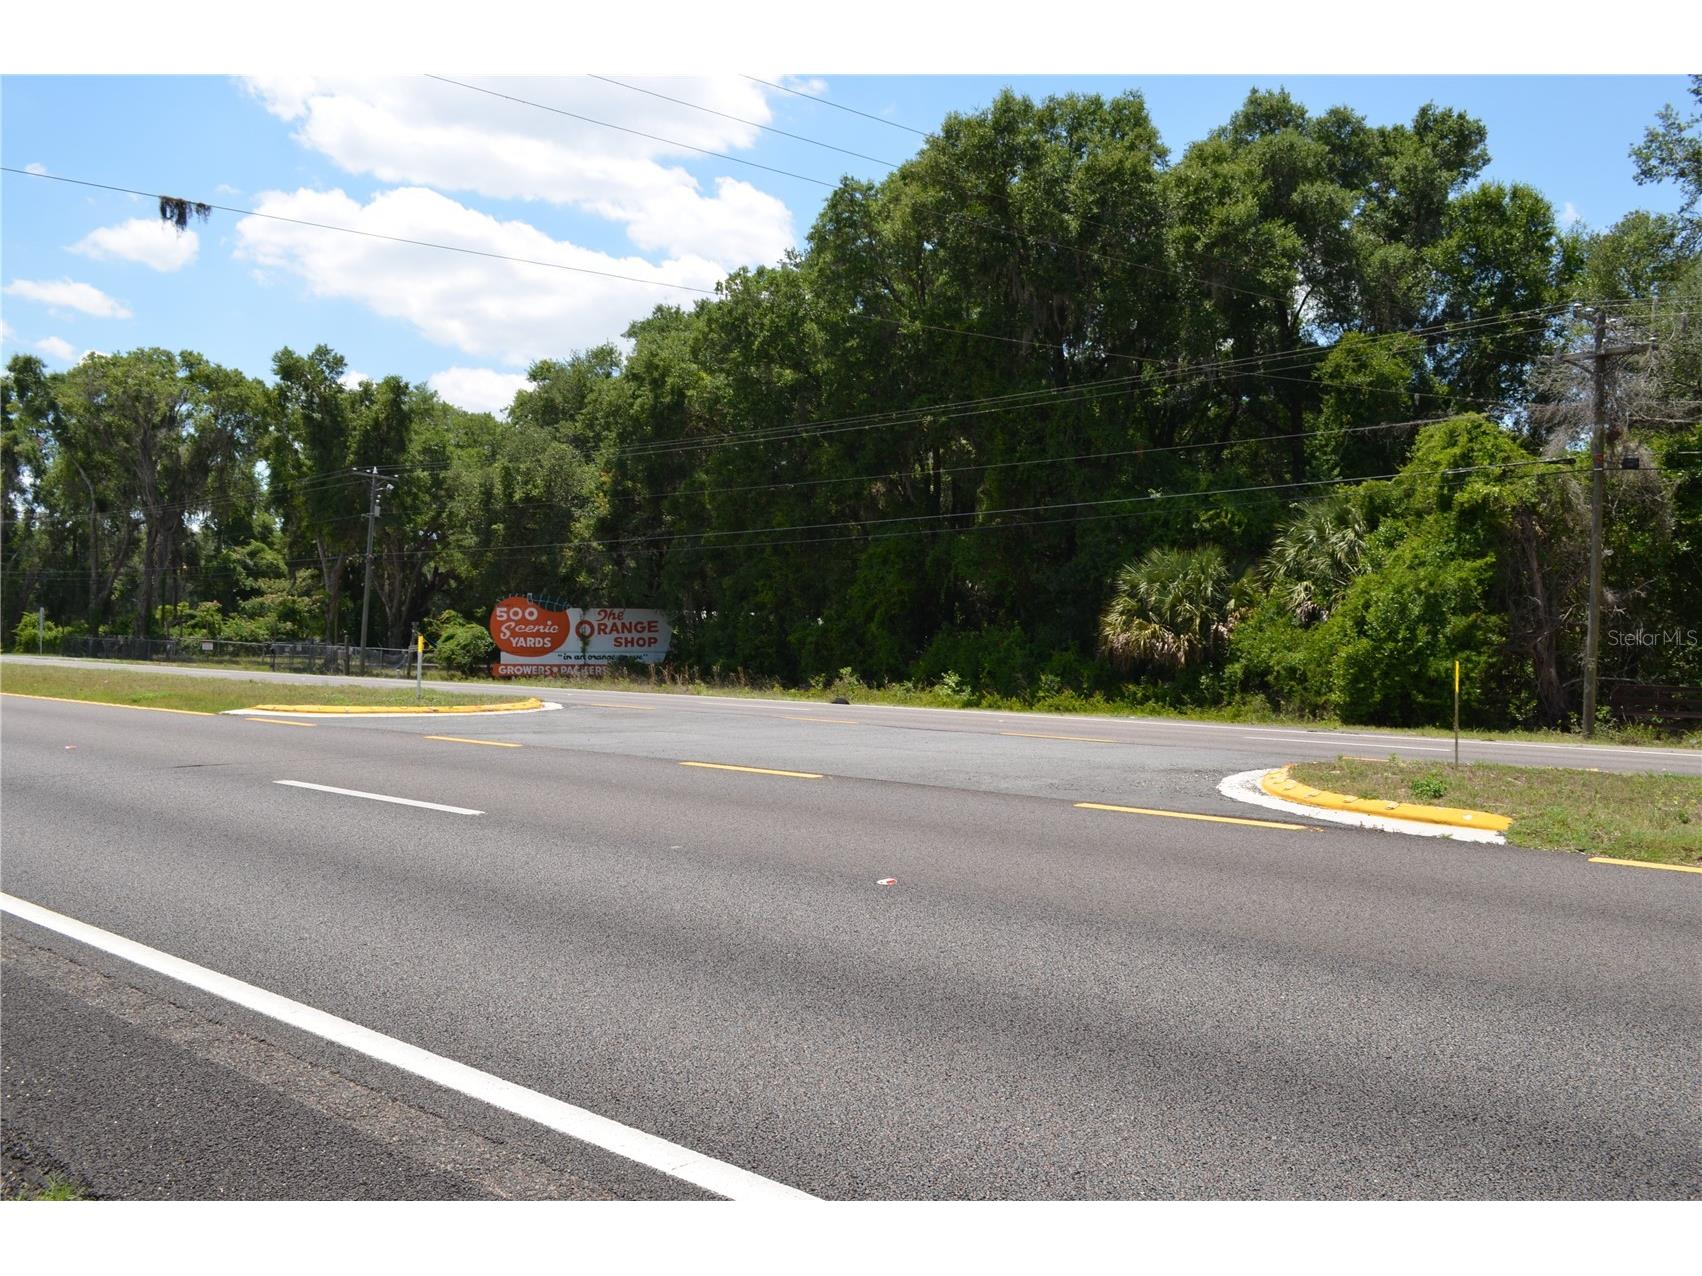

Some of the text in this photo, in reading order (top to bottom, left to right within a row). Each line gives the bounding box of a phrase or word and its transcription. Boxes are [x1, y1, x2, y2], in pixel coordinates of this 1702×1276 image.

[496, 607, 538, 620] 500
[595, 609, 625, 621] The
[500, 621, 559, 640] Scenic
[575, 620, 659, 639] ORANGE
[510, 637, 552, 648] YARDS
[613, 636, 658, 648] SHOP
[498, 665, 550, 675] GROWERS
